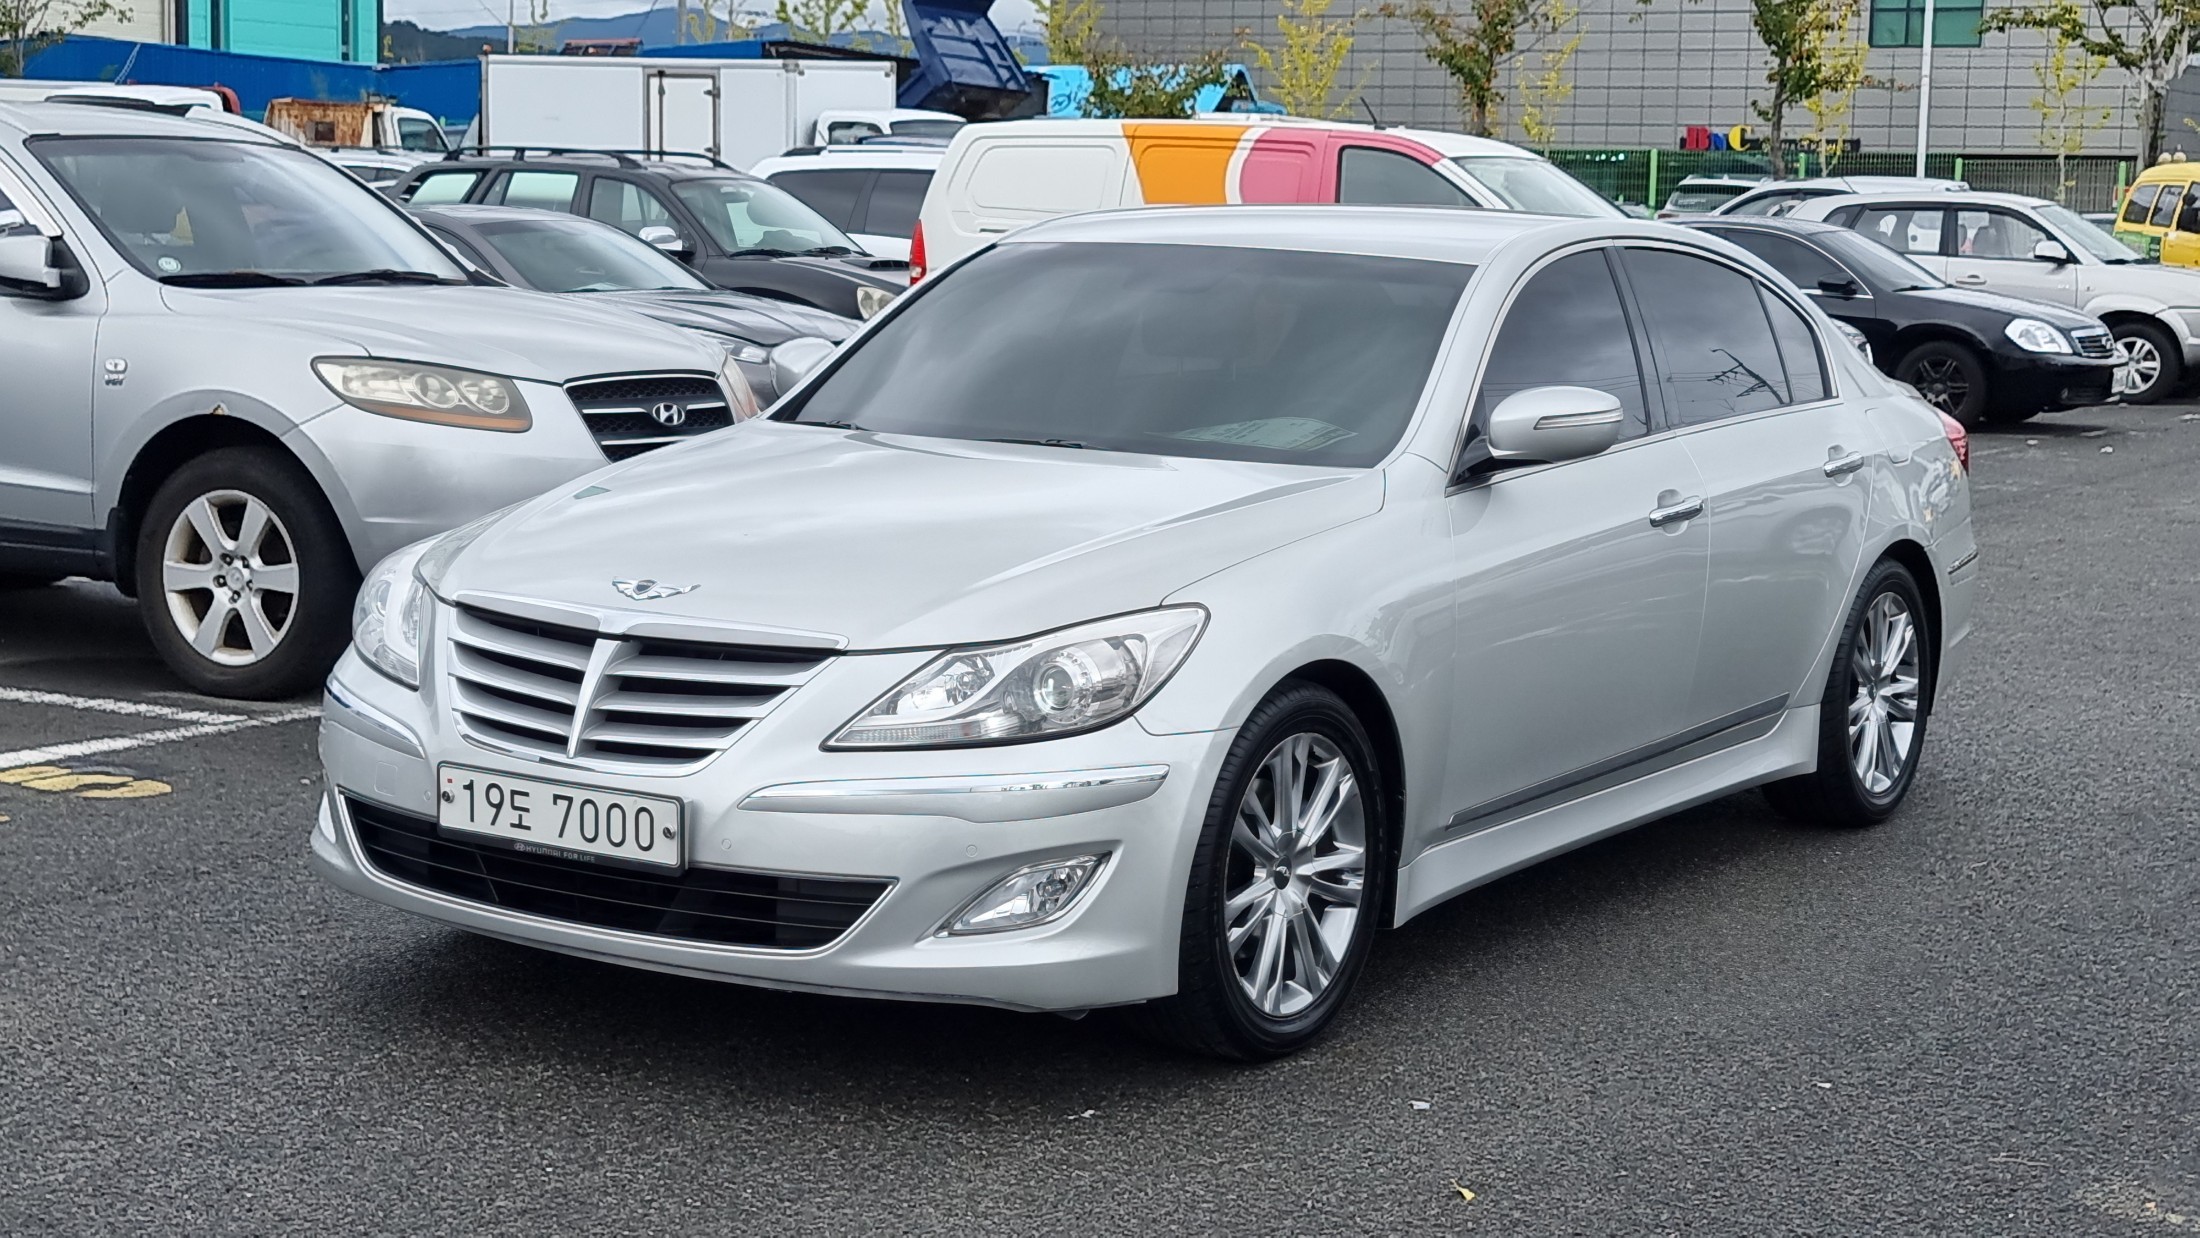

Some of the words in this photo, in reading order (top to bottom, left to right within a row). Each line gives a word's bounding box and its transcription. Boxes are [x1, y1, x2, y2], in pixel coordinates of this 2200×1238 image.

[462, 779, 531, 831] 19도
[552, 793, 655, 852] 7000
[563, 851, 578, 861] FOR
[580, 855, 595, 863] LIFE
